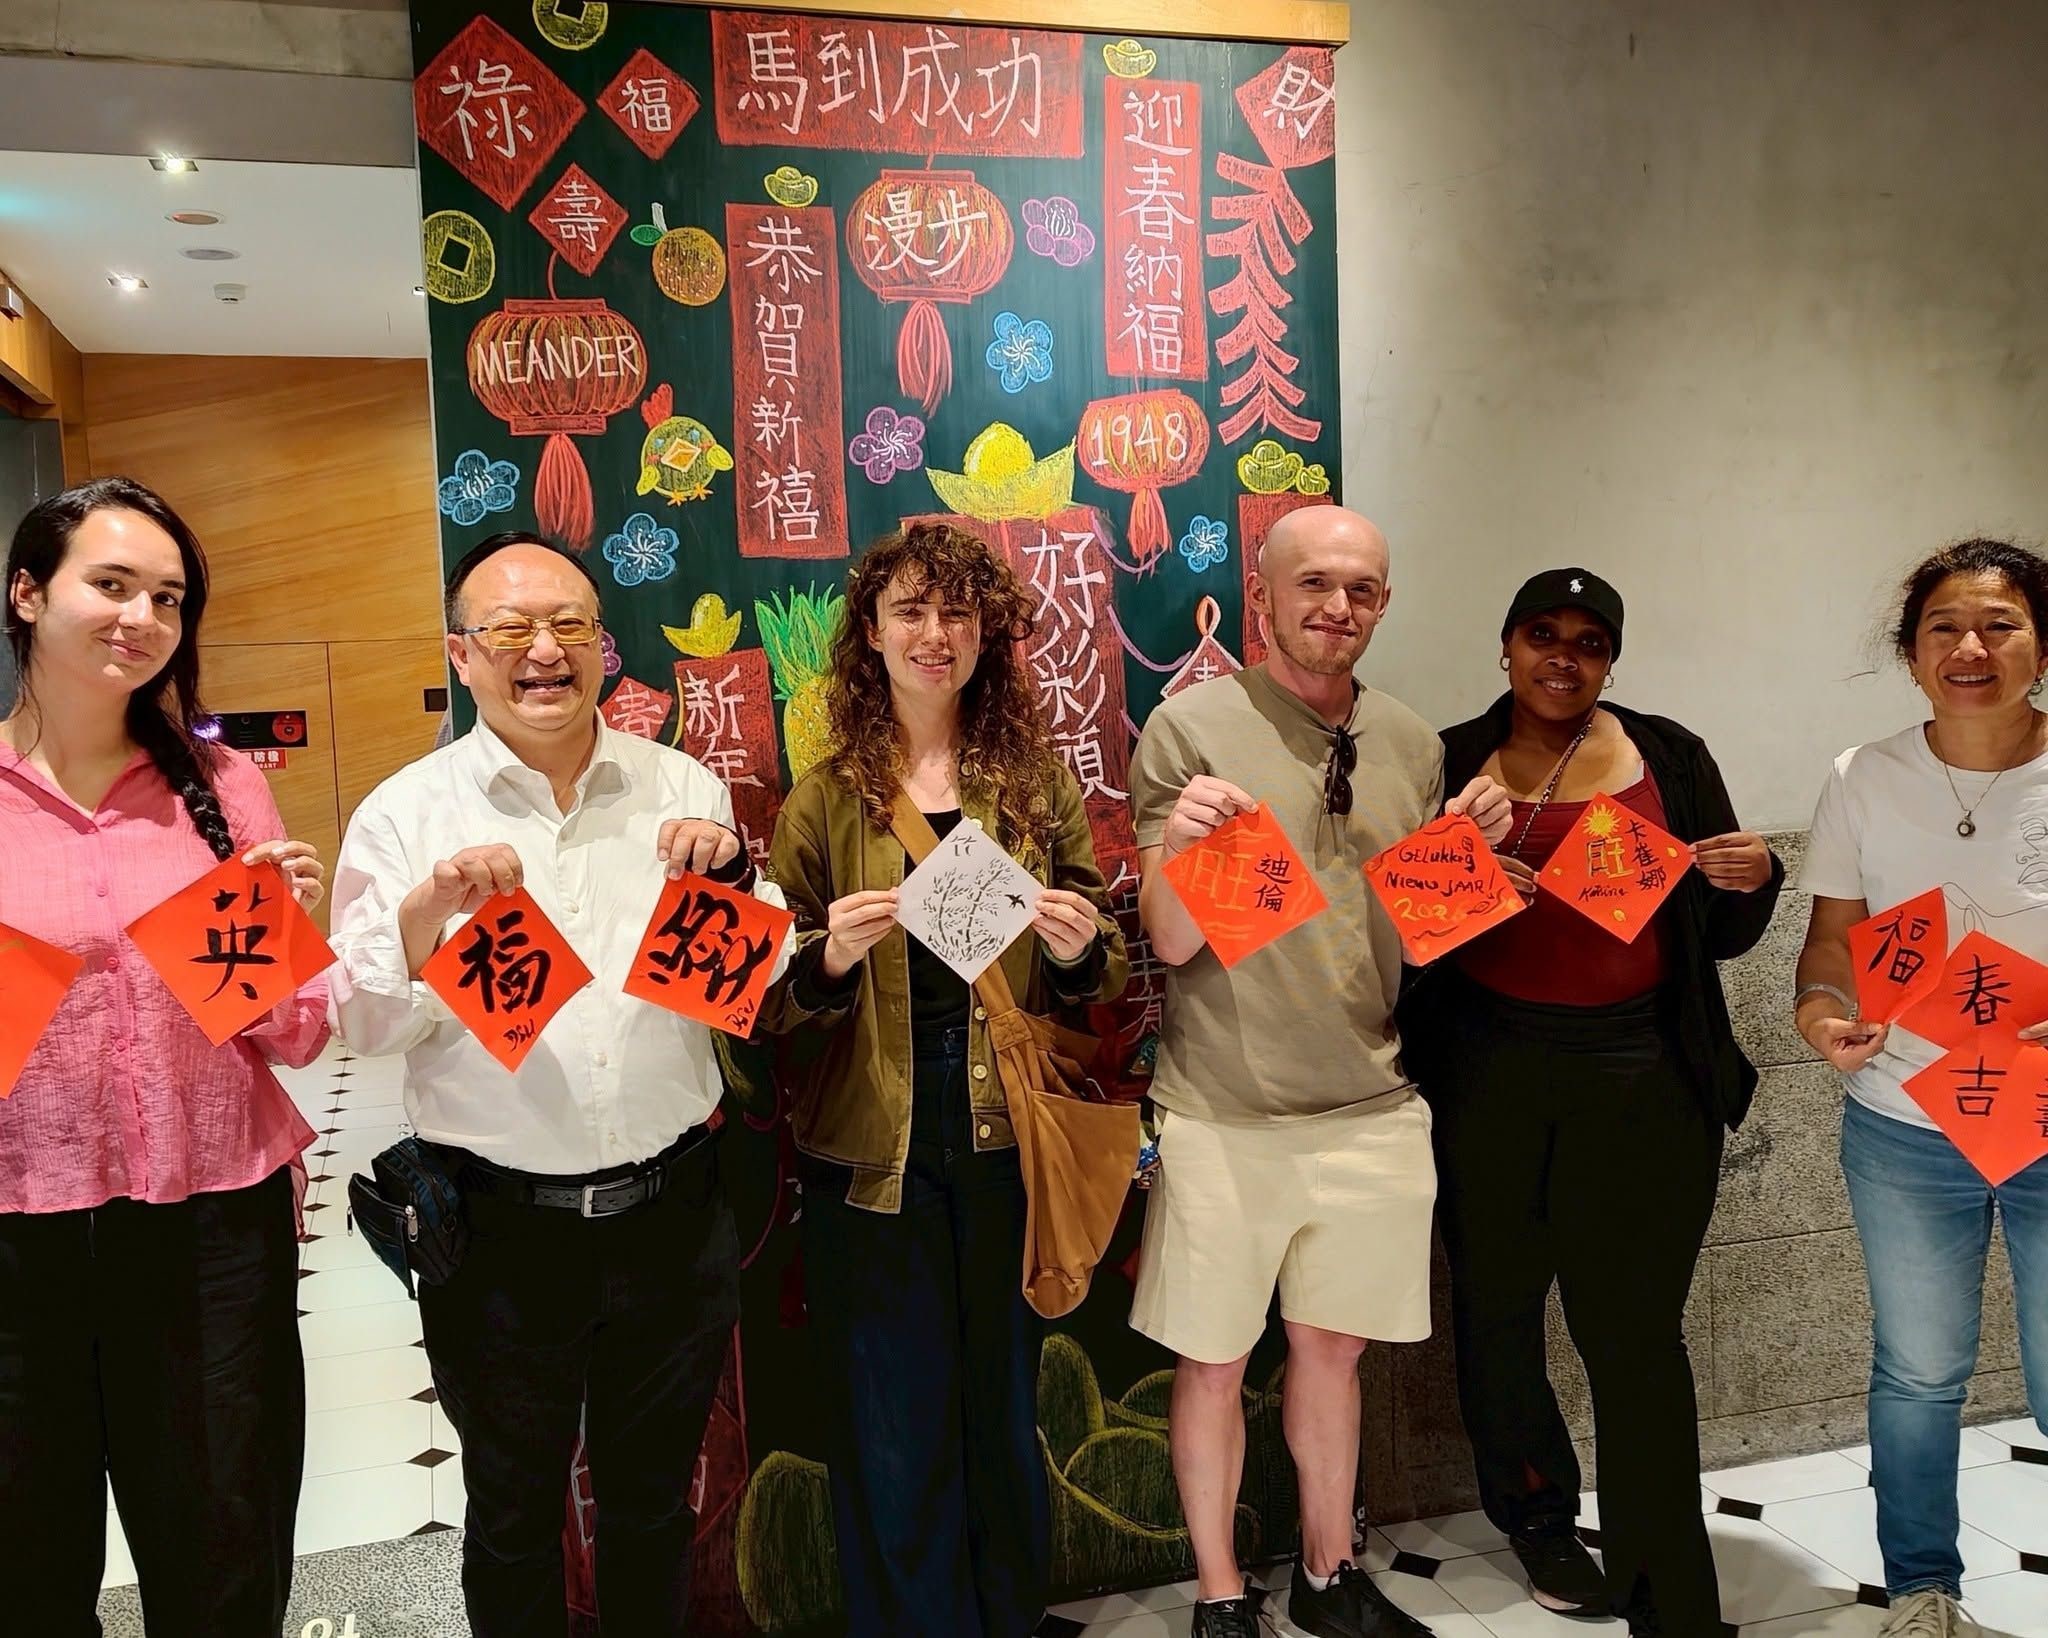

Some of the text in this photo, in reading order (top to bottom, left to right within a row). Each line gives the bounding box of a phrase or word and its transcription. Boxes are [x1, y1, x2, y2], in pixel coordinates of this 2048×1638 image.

[440, 59, 531, 161] 祿
[618, 78, 673, 133] 福
[737, 26, 1042, 138] 馬到成功
[1262, 62, 1336, 140] 財
[547, 180, 608, 253] 壽
[864, 189, 988, 279] 漫步
[1117, 89, 1195, 375] 迎春納福
[475, 335, 641, 387] MEANDER
[746, 215, 823, 542] 恭賀新禧
[1090, 412, 1188, 467] 1948
[1253, 850, 1294, 913] 迪倫
[1586, 836, 1636, 880] 旺
[1625, 818, 1667, 891] 卡崔娜
[188, 881, 279, 1004] 英
[457, 909, 552, 1014] 福
[1867, 910, 1932, 986] 福
[1953, 953, 2013, 1026] 春
[1947, 1055, 2008, 1117] 吉
